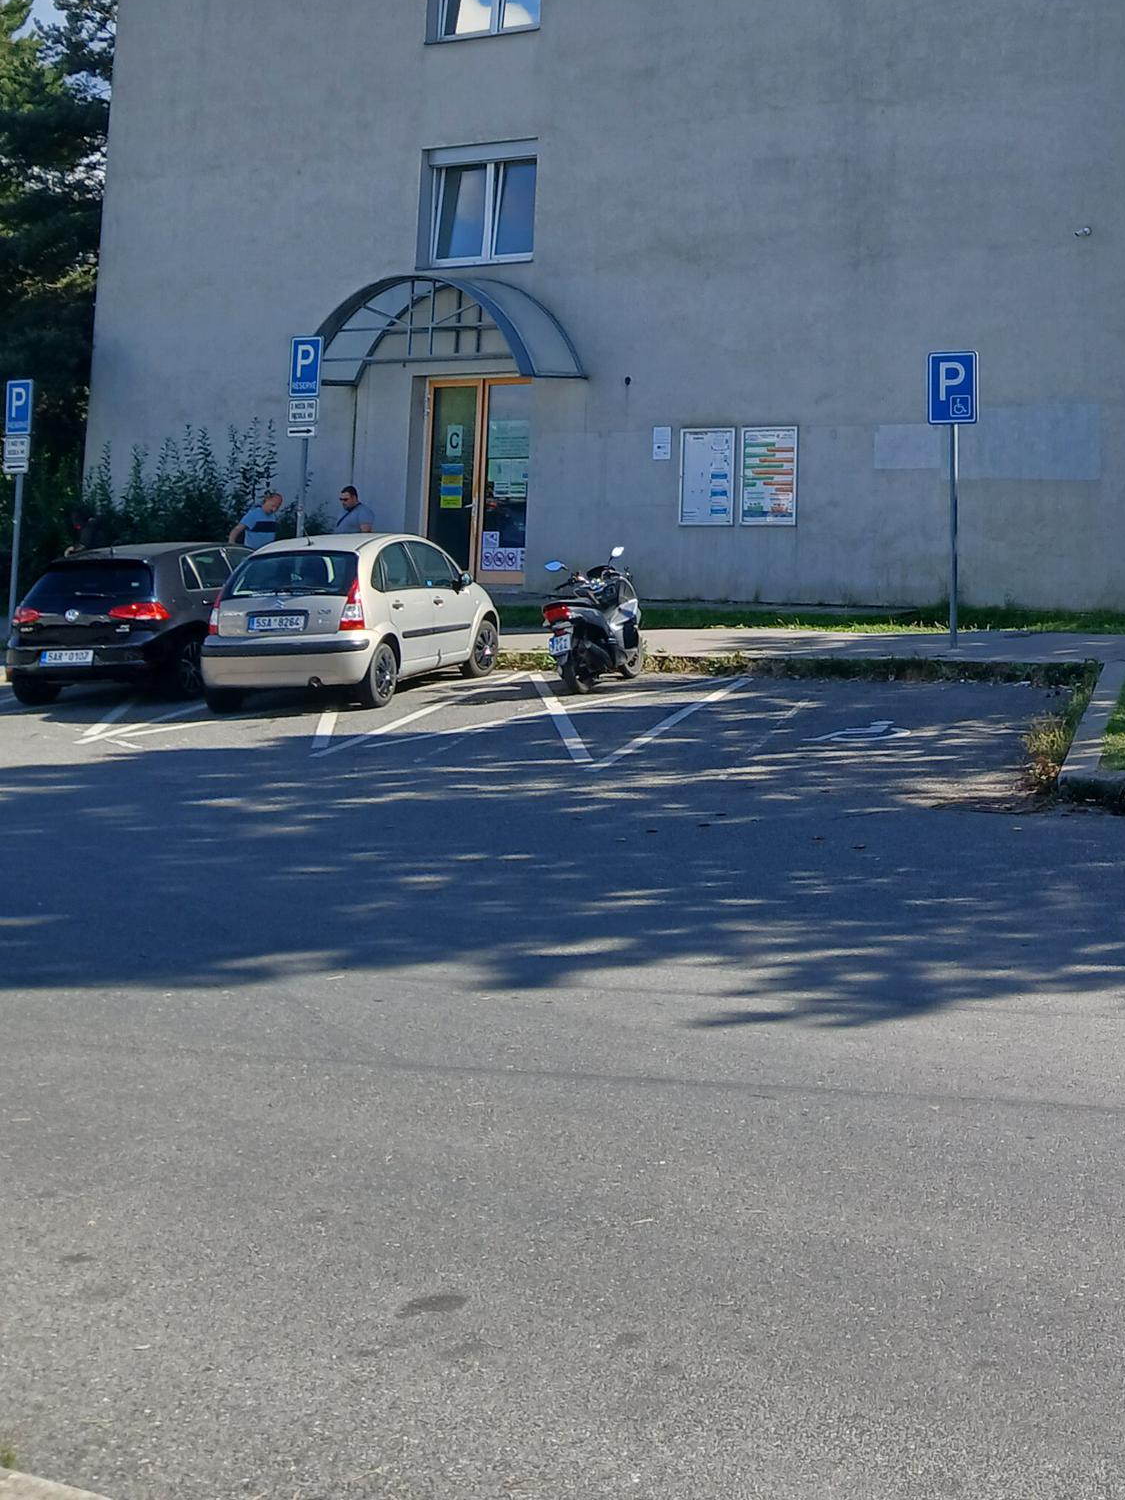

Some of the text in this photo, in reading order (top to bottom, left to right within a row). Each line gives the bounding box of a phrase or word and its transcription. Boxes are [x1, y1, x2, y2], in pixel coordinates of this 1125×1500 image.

[296, 344, 315, 378] P
[939, 361, 965, 401] P
[11, 387, 26, 418] P
[449, 432, 460, 449] C
